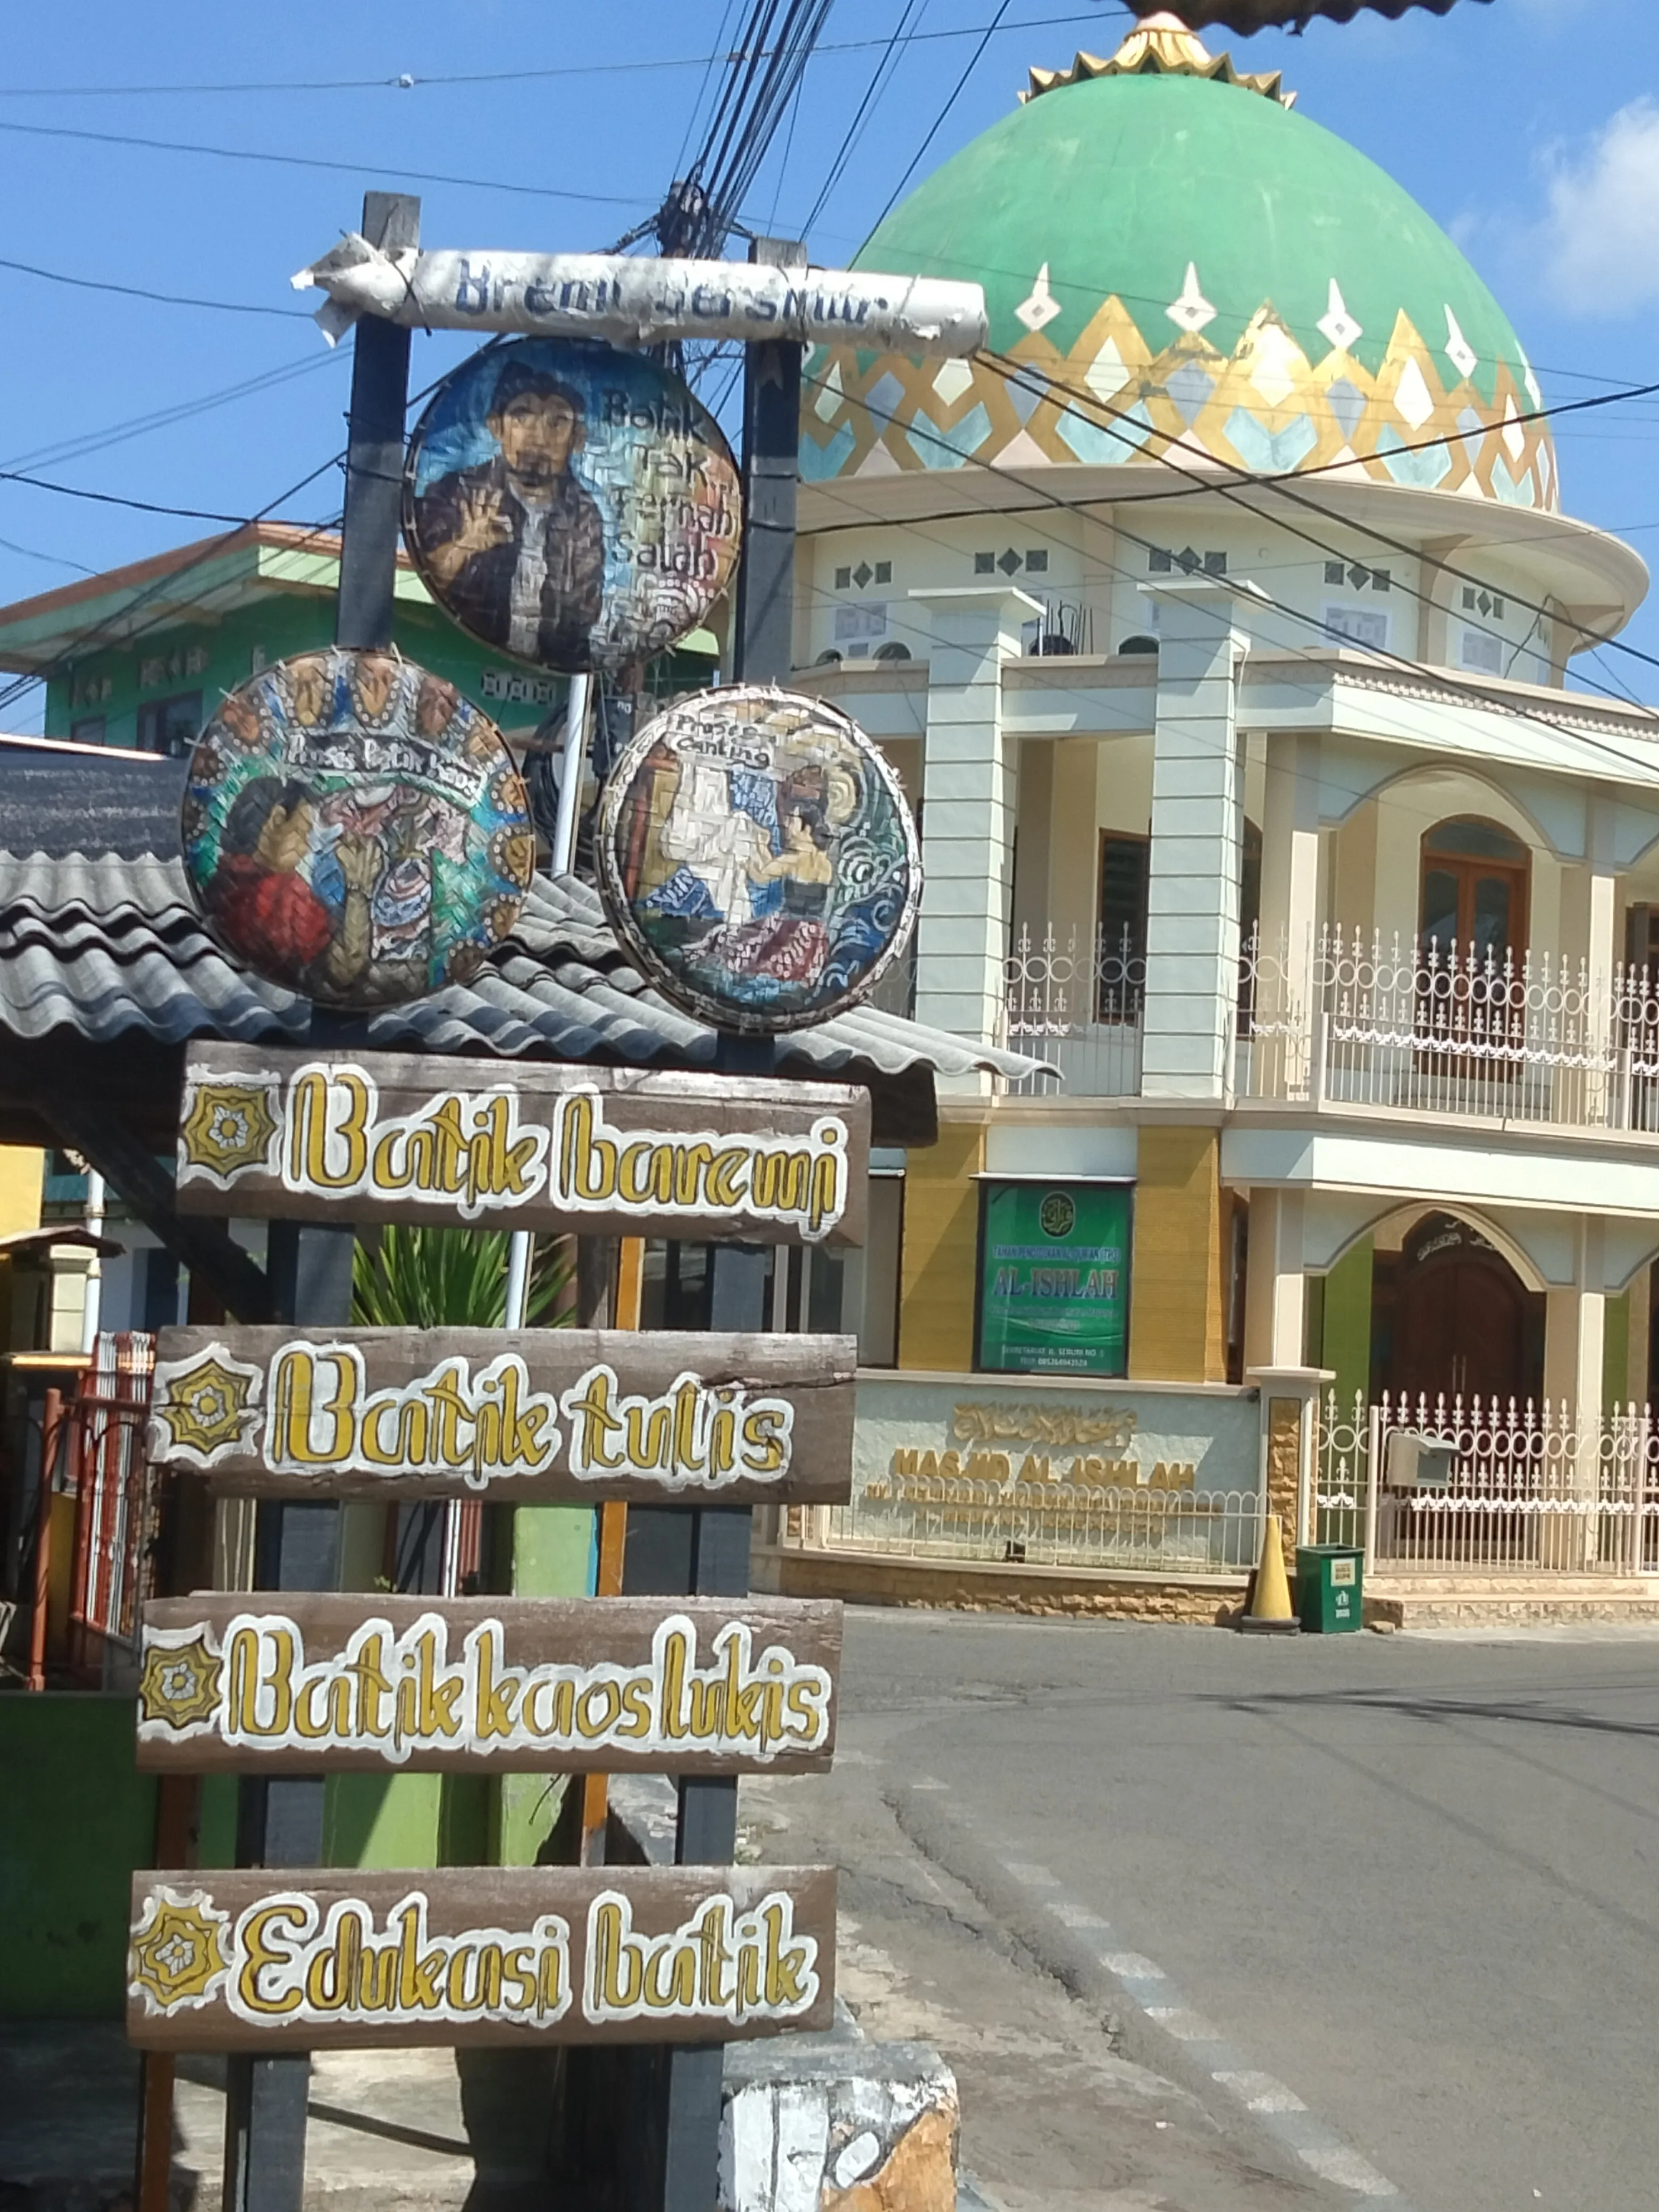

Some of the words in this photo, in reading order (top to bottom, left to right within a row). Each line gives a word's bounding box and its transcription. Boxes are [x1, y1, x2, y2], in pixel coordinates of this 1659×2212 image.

[290, 1069, 538, 1209] Batik
[273, 1350, 553, 1482] Batik
[568, 1371, 787, 1480] tulis
[893, 1447, 1010, 1484] MASJID
[229, 1626, 463, 1754] Batik
[475, 1628, 654, 1740] kaos
[661, 1630, 822, 1754] lukis
[238, 1899, 562, 2021] Edukasi
[593, 1899, 808, 2018] batik
